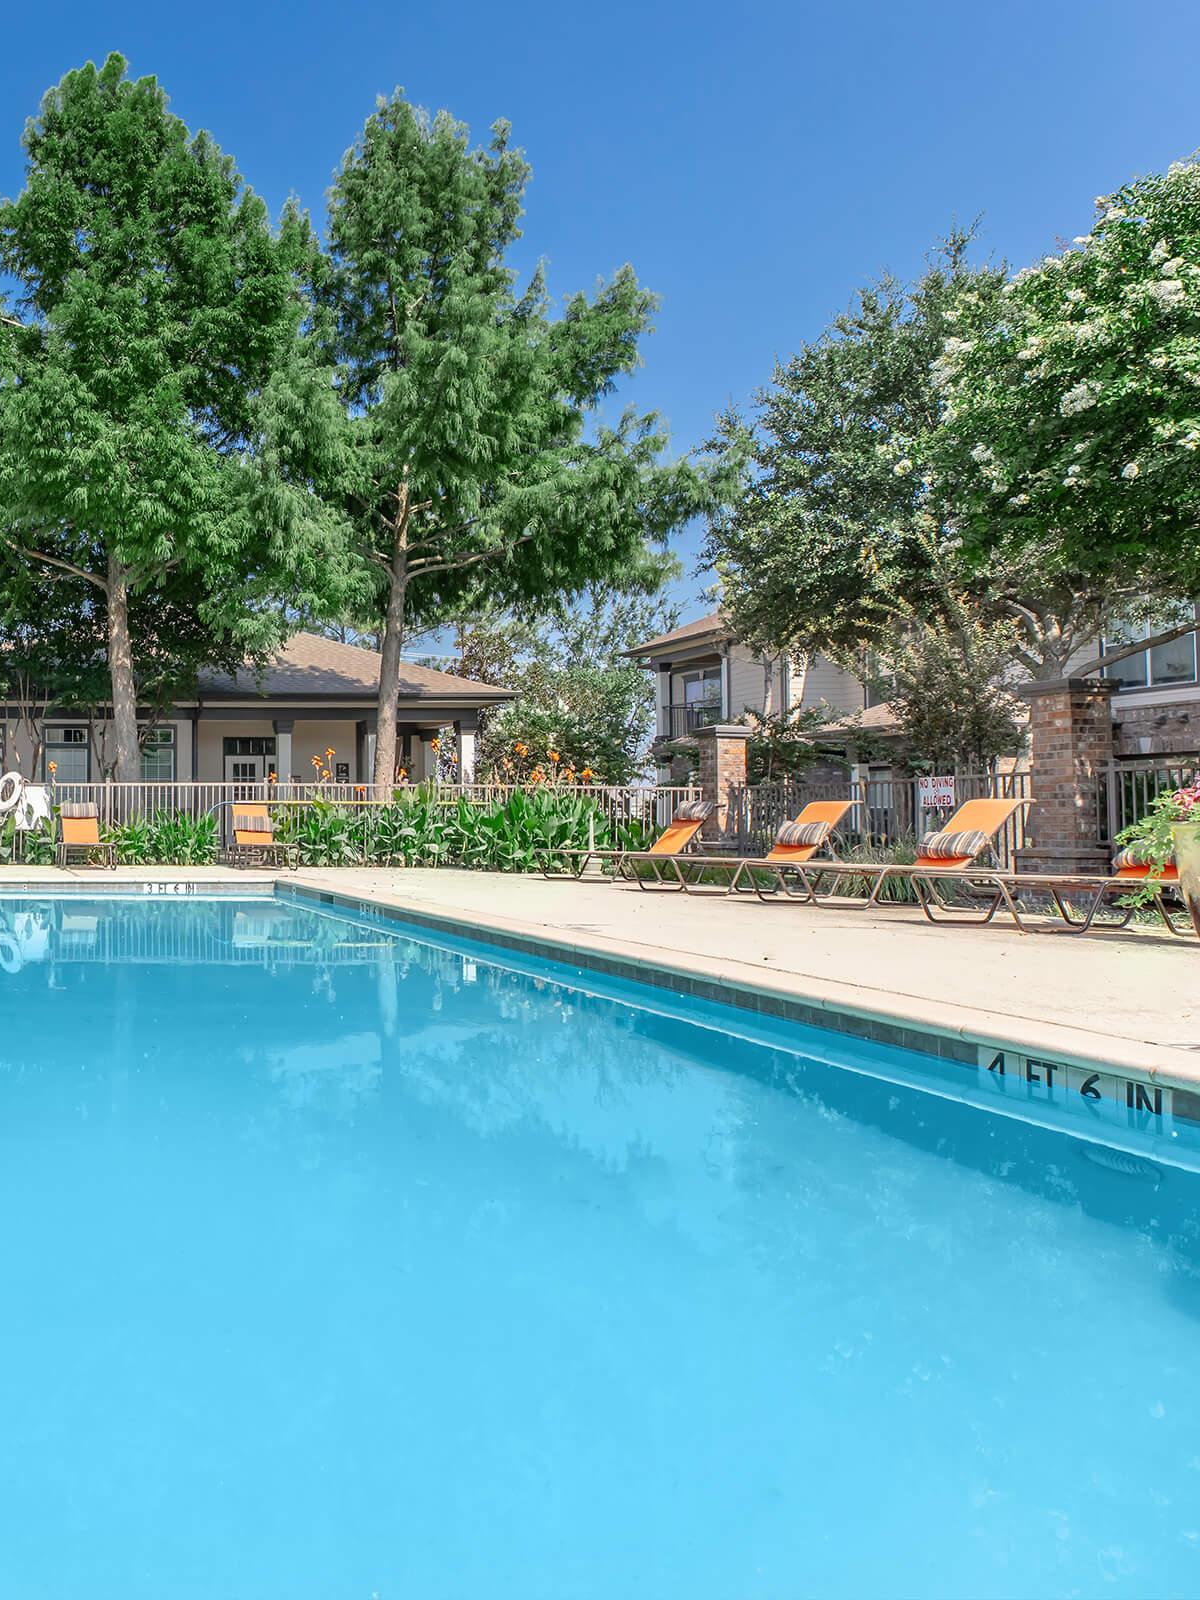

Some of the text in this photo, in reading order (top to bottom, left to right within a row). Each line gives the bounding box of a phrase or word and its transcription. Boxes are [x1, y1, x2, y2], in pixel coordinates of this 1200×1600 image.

[920, 777, 953, 788] NO DIVING
[923, 795, 951, 805] ALLOWED
[987, 1051, 1162, 1116] 4 FT 6 IN
